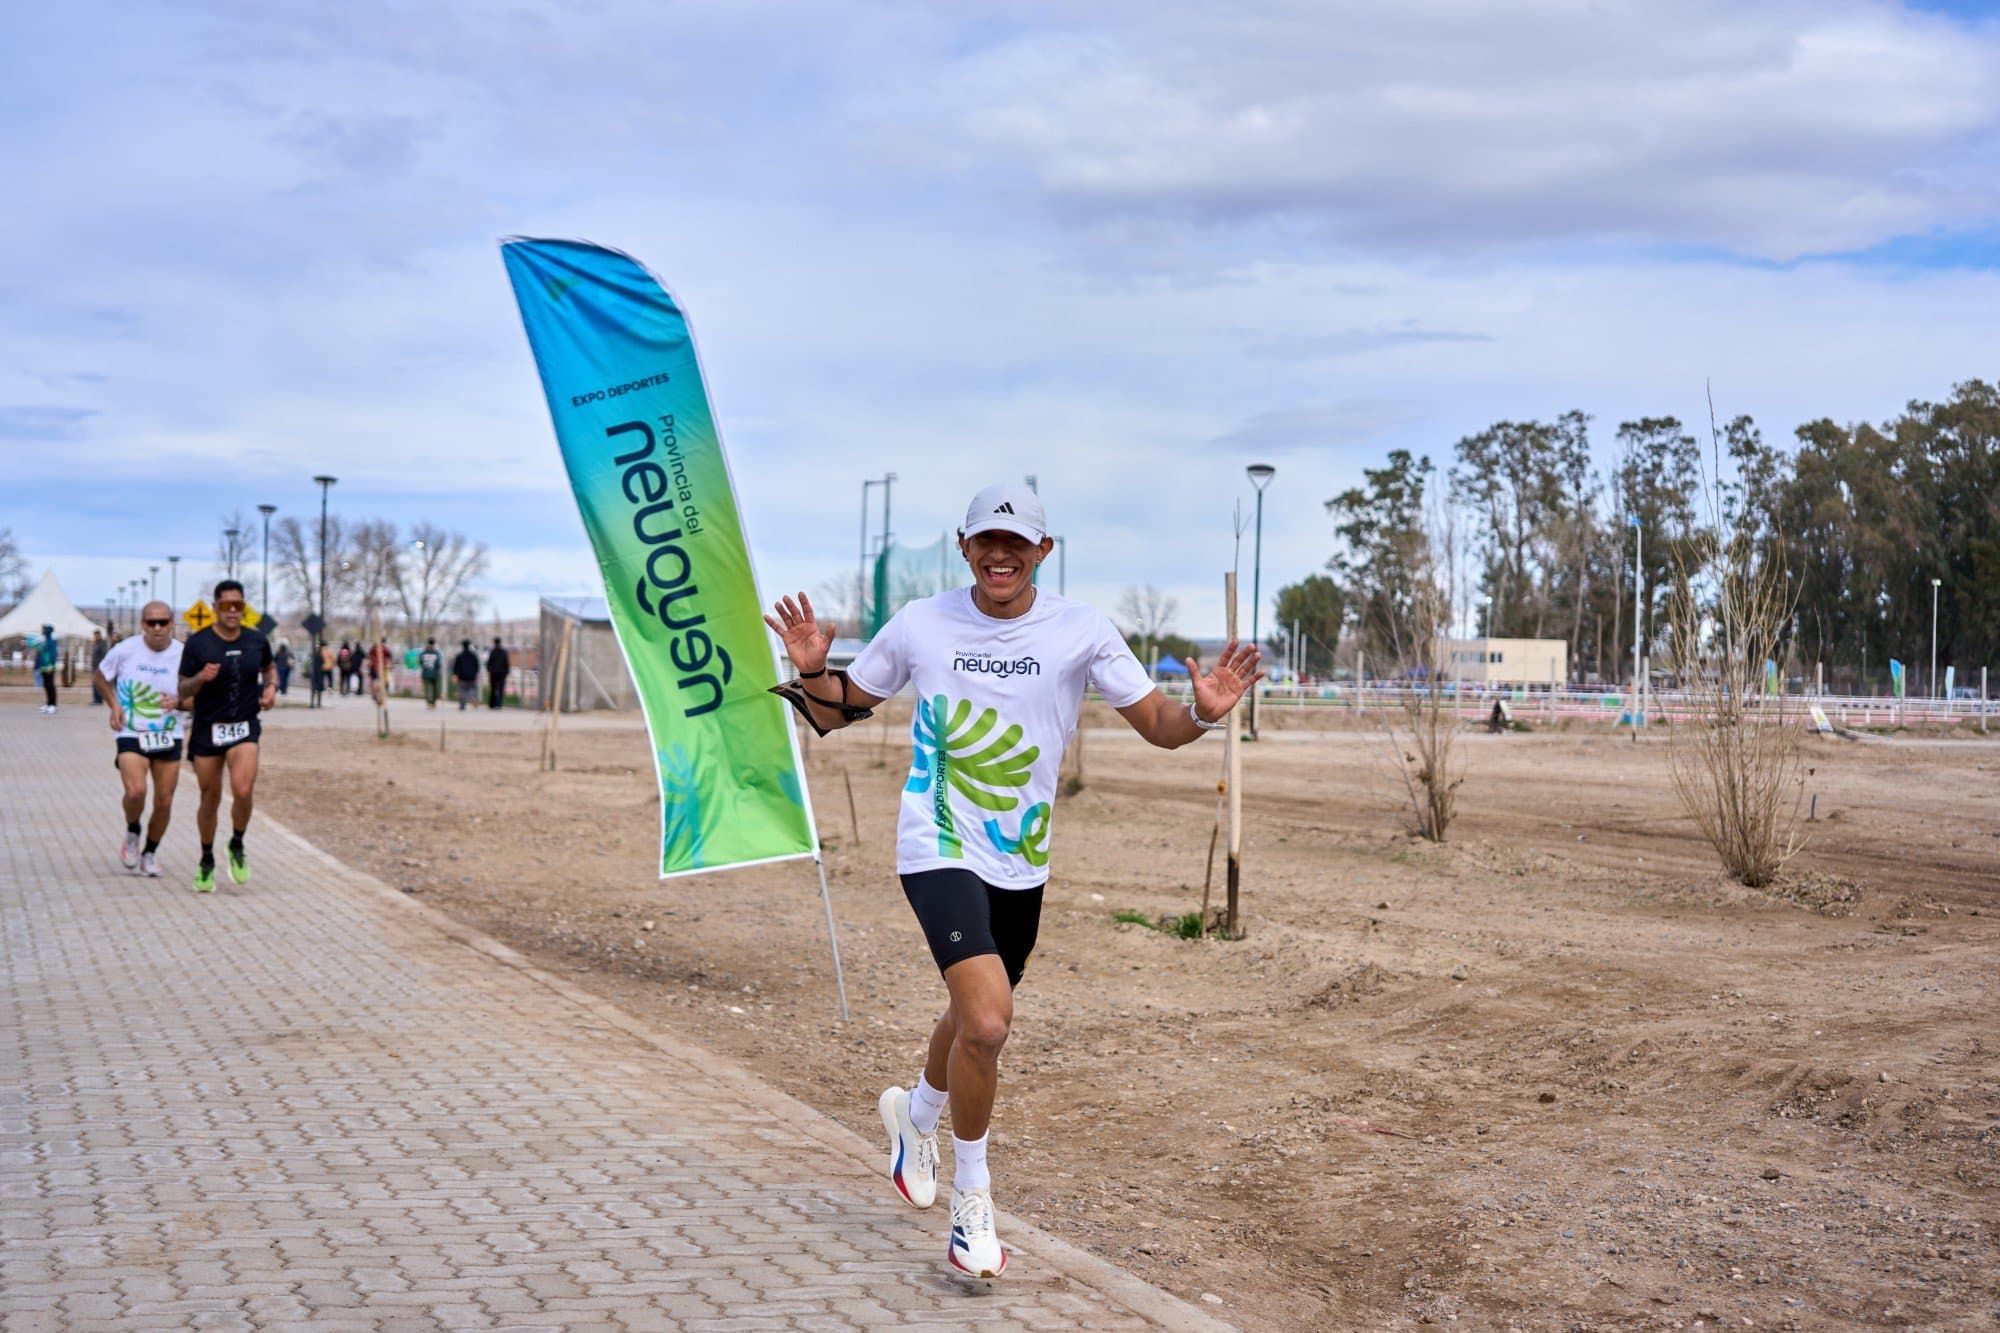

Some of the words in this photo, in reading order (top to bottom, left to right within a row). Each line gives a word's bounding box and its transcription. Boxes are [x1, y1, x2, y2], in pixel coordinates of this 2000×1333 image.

[572, 390, 605, 407] EXPO
[607, 373, 670, 398] DEPORTES
[658, 413, 692, 502] Provincia
[682, 504, 704, 535] del
[144, 732, 169, 745] 116
[218, 723, 245, 739] 346
[936, 750, 946, 803] DEPORTES
